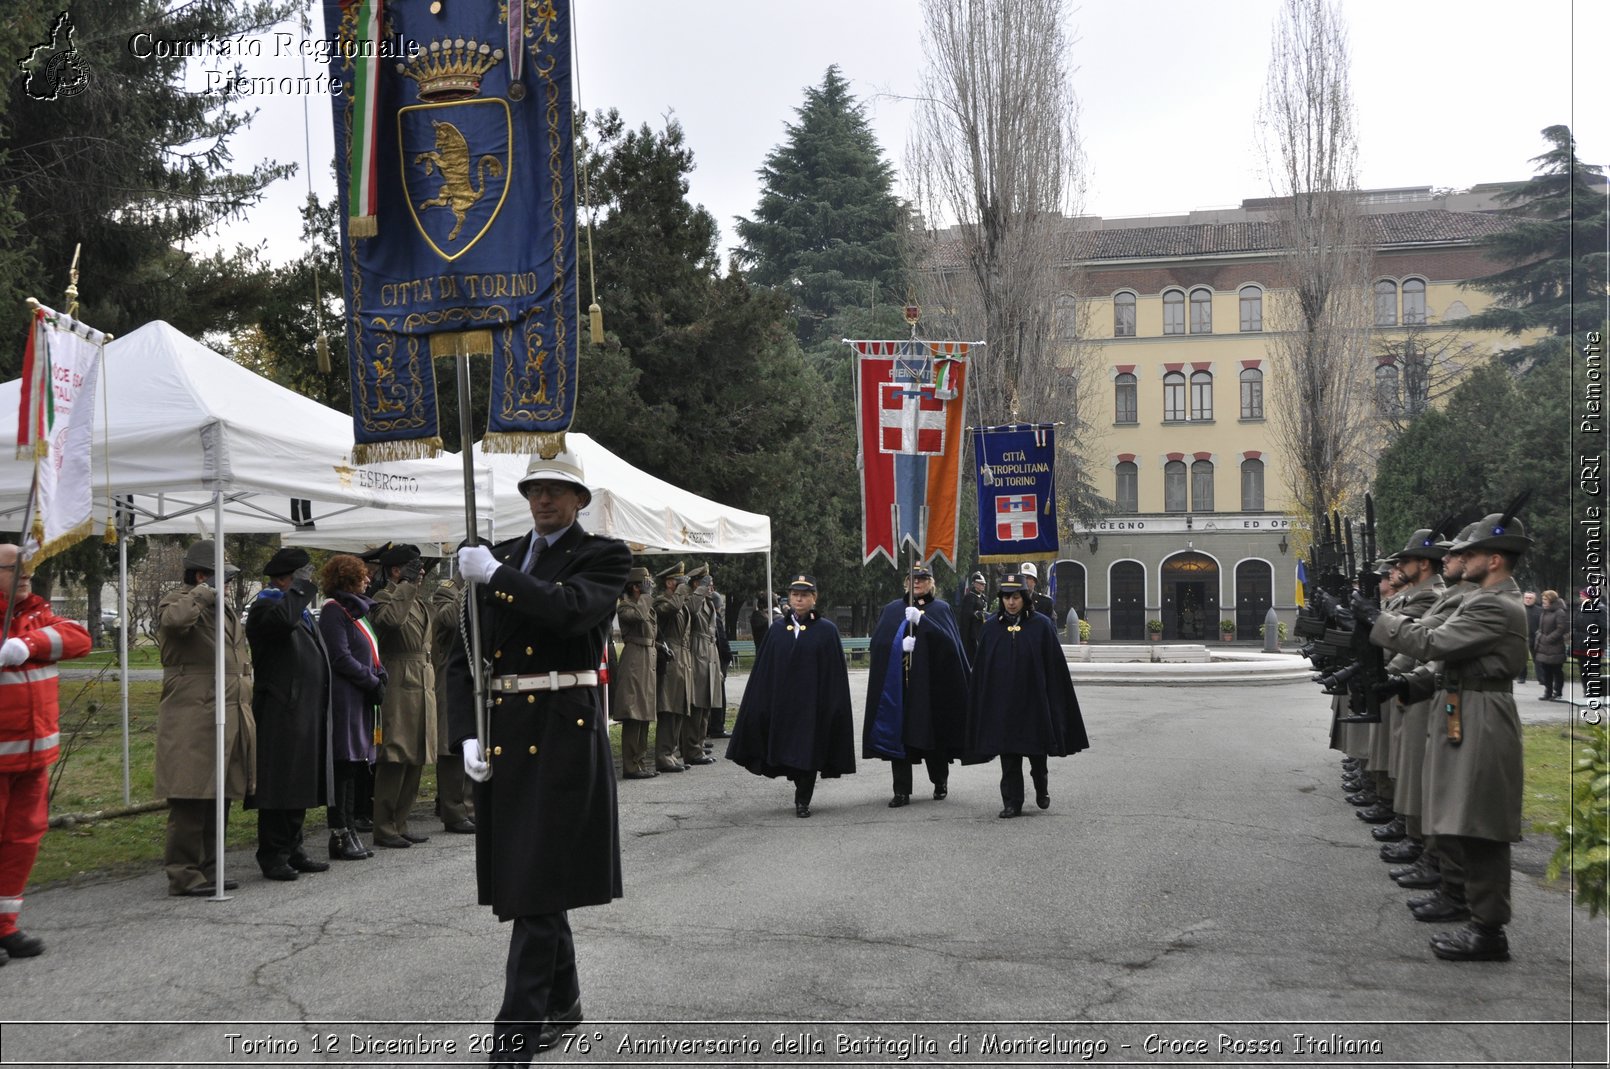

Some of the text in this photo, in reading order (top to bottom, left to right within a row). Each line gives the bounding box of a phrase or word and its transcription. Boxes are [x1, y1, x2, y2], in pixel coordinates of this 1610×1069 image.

[438, 275, 458, 299] DI
[464, 272, 537, 299] TORINO
[1002, 450, 1026, 462] CITTÀ
[359, 469, 419, 494] ESERCITO
[994, 476, 1036, 487] DI TORINO
